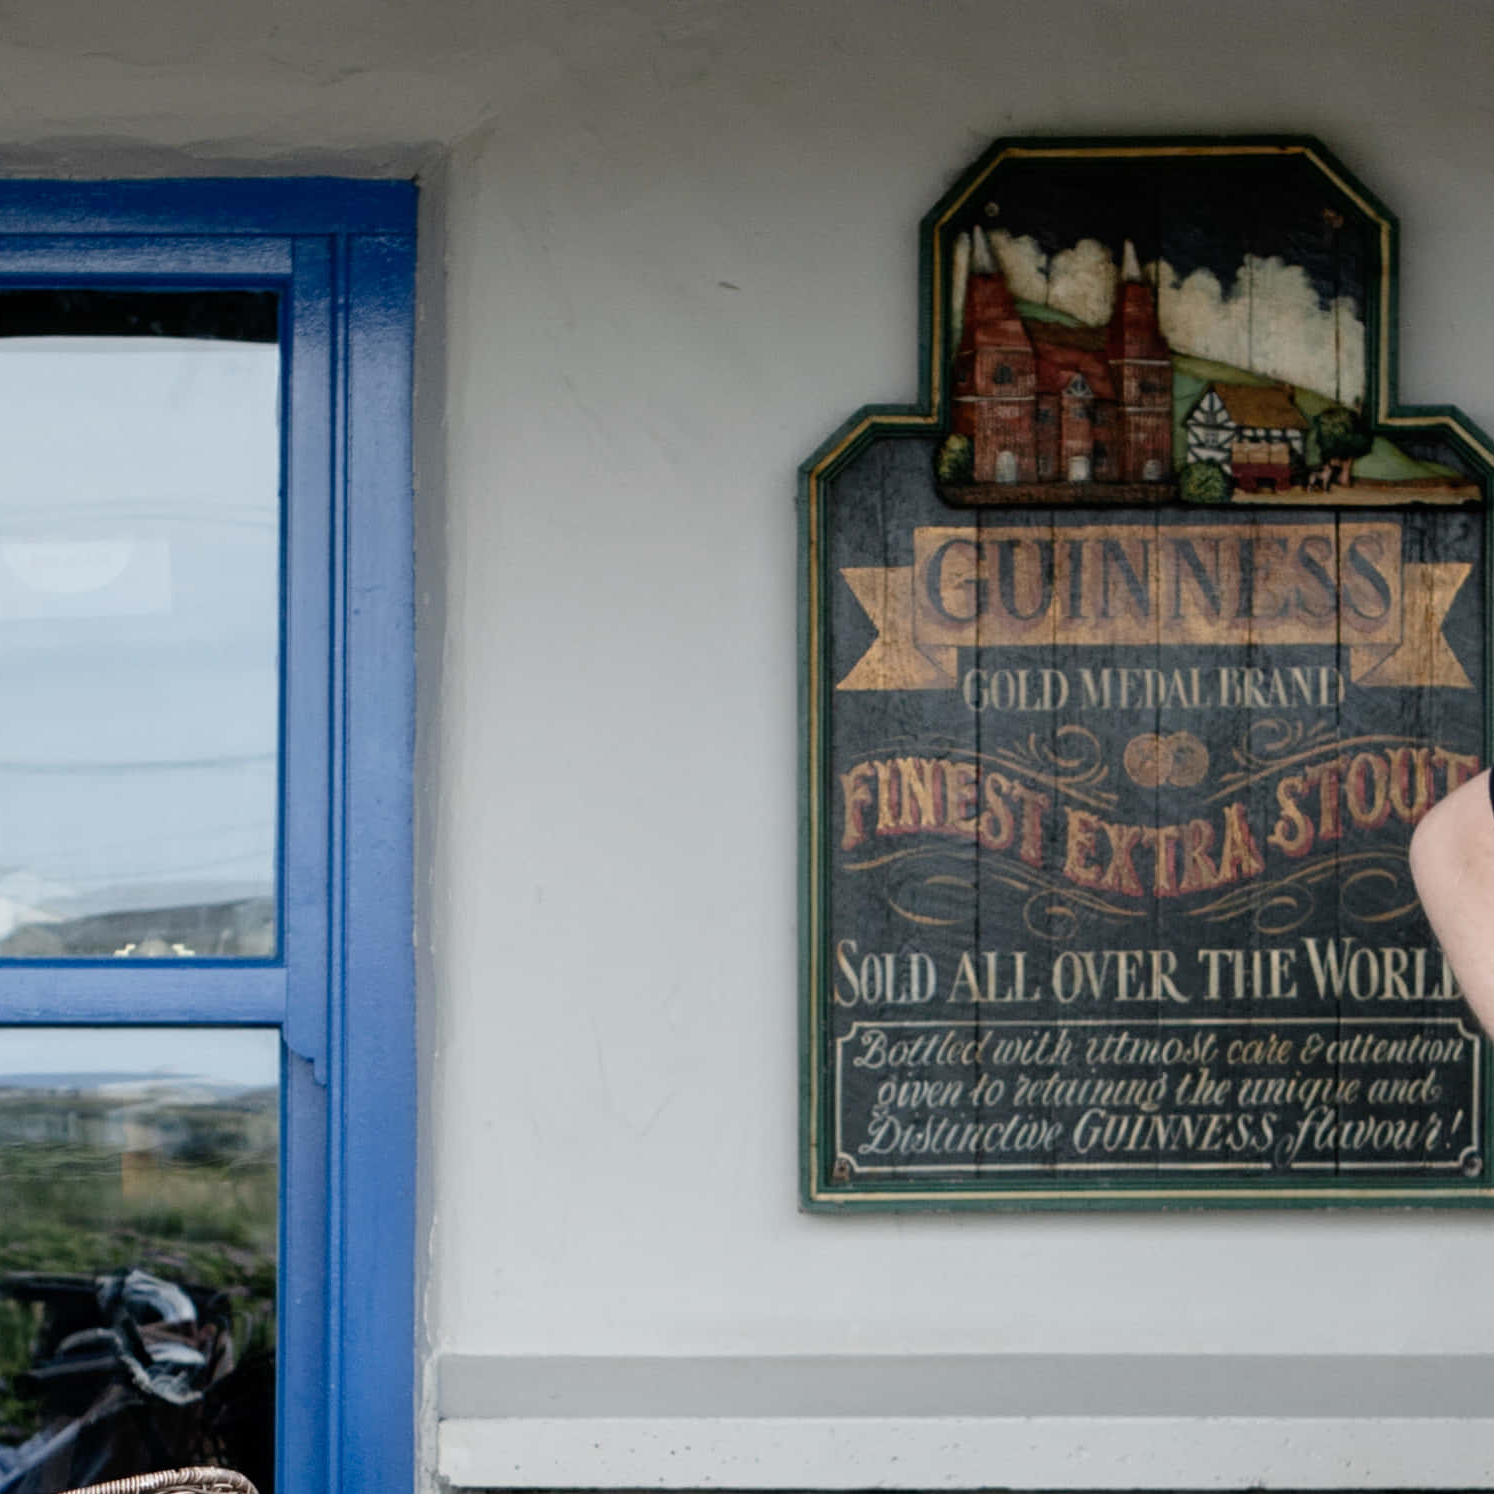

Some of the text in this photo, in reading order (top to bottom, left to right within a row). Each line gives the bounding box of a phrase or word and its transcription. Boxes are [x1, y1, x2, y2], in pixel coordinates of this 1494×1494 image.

[923, 535, 1394, 634] GUINNESS
[962, 666, 1346, 713] GOLD MEDAL BRAND
[840, 747, 1480, 896] FINEST EXTRA STOUT
[833, 939, 937, 1008] SOLD
[946, 950, 1041, 1003] ALL
[1052, 950, 1189, 1003] OVER
[1198, 947, 1298, 1001] THE
[853, 1028, 1464, 1069] Bottled with utmost care & attention
[871, 1068, 1443, 1118] given to retaining the unique and
[858, 1105, 1464, 1168] Distinctive GUINNESS flavour!
